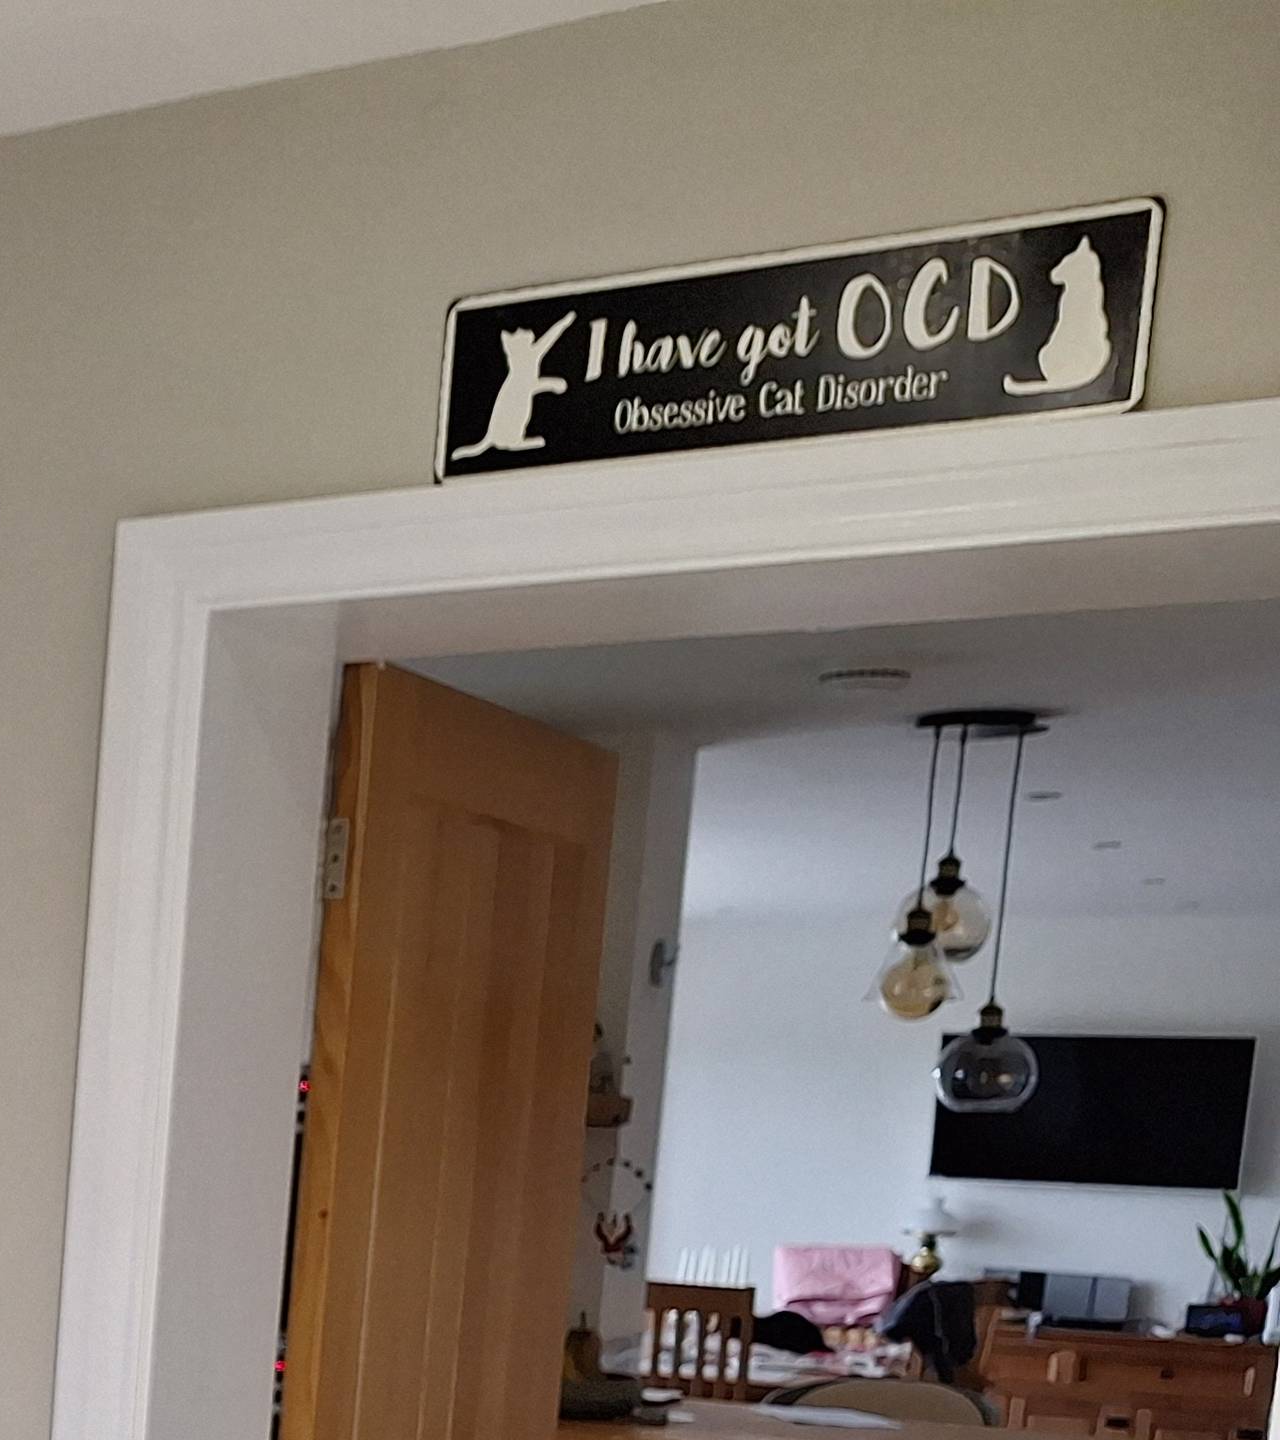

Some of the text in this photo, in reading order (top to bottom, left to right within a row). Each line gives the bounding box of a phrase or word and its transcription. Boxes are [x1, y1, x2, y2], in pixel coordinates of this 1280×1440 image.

[584, 255, 1023, 386] I have got OCD
[614, 366, 949, 435] Obsessive Cat Disorder
